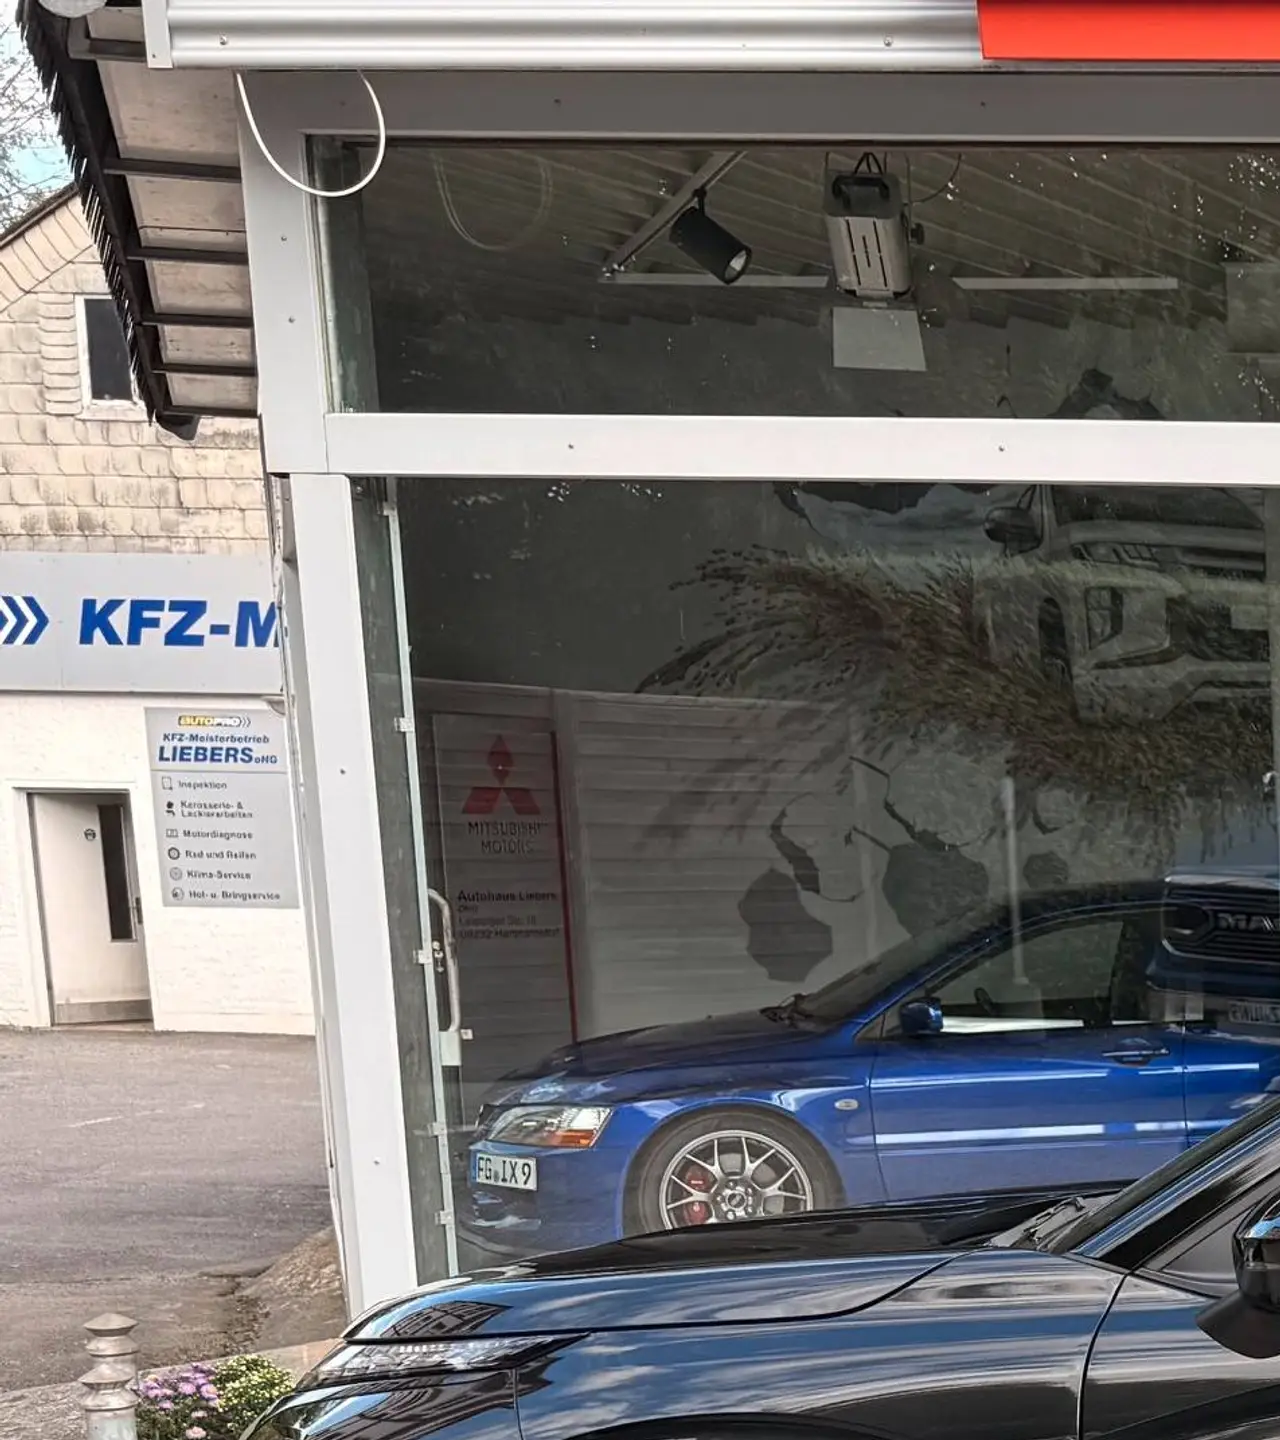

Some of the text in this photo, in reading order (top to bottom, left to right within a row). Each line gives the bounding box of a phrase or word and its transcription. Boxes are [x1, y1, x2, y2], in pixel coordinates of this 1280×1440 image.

[163, 733, 270, 744] KFZ-Meisterbetrieb
[158, 745, 254, 764] LIEBERS
[178, 780, 227, 791] Inspektion
[183, 830, 253, 840] Motordiagnose
[187, 870, 251, 879] Klima-Service
[522, 1163, 531, 1185] 9
